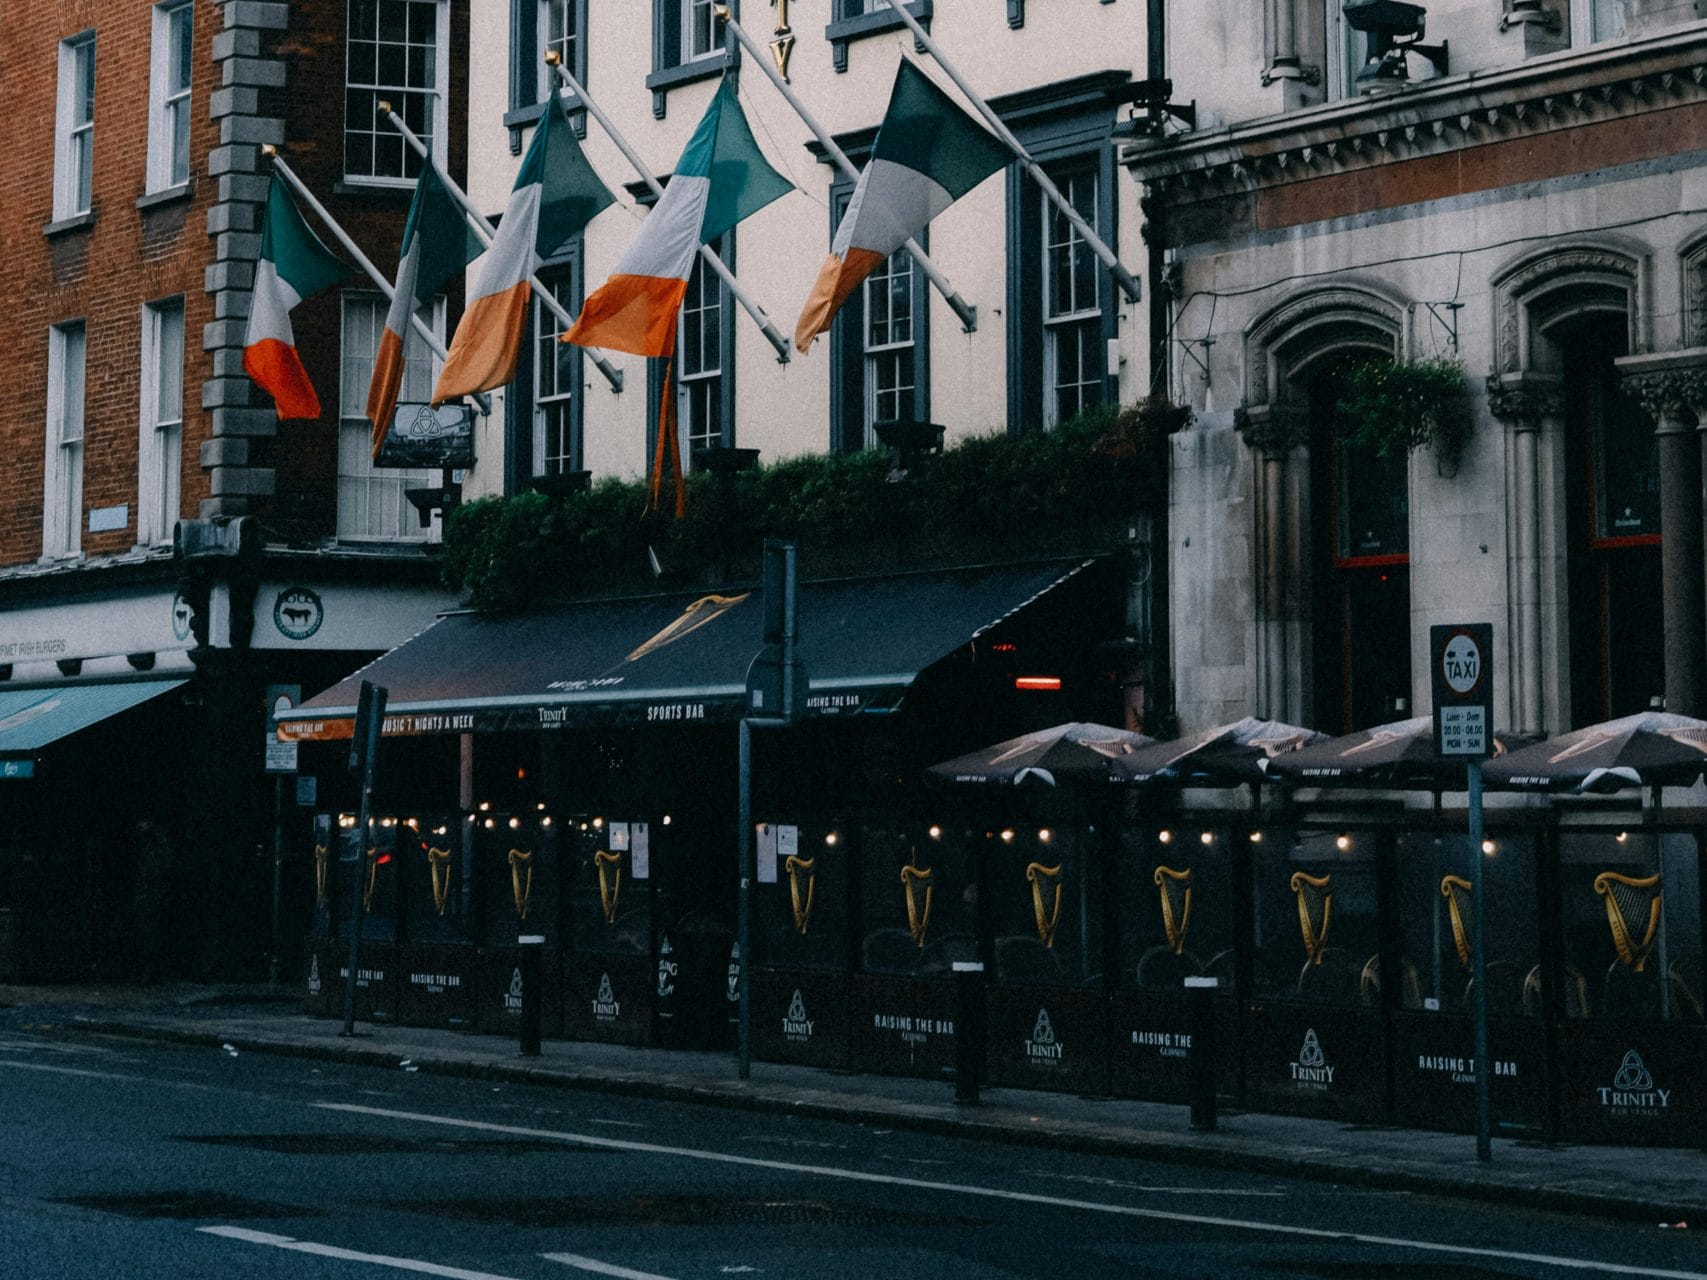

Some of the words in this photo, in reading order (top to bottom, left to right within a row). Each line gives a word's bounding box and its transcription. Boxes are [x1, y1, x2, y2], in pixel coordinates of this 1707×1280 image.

[1446, 661, 1477, 679] TAXI
[806, 696, 830, 708] AISING
[538, 706, 568, 722] TRINITY
[647, 705, 682, 721] SPORTS
[685, 703, 704, 719] BAR
[407, 718, 412, 732] 7
[414, 715, 443, 731] NIGHTS
[444, 715, 451, 729] A
[452, 714, 474, 729] WEEK
[1446, 739, 1461, 749] MON
[1467, 738, 1481, 749] SUN
[591, 999, 620, 1016] TRINITY
[782, 1017, 814, 1036] TRINITY
[873, 1014, 912, 1032] RAISING
[914, 1018, 933, 1033] THE
[936, 1020, 954, 1035] BAR
[1131, 1030, 1171, 1047] RAISING
[1174, 1034, 1193, 1048] THE
[1025, 1039, 1065, 1059] TRINITY
[1290, 1061, 1335, 1083] TRINITY
[1418, 1055, 1465, 1073] RAISING
[1494, 1060, 1518, 1077] BAR
[1596, 1086, 1671, 1108] TRINITY
